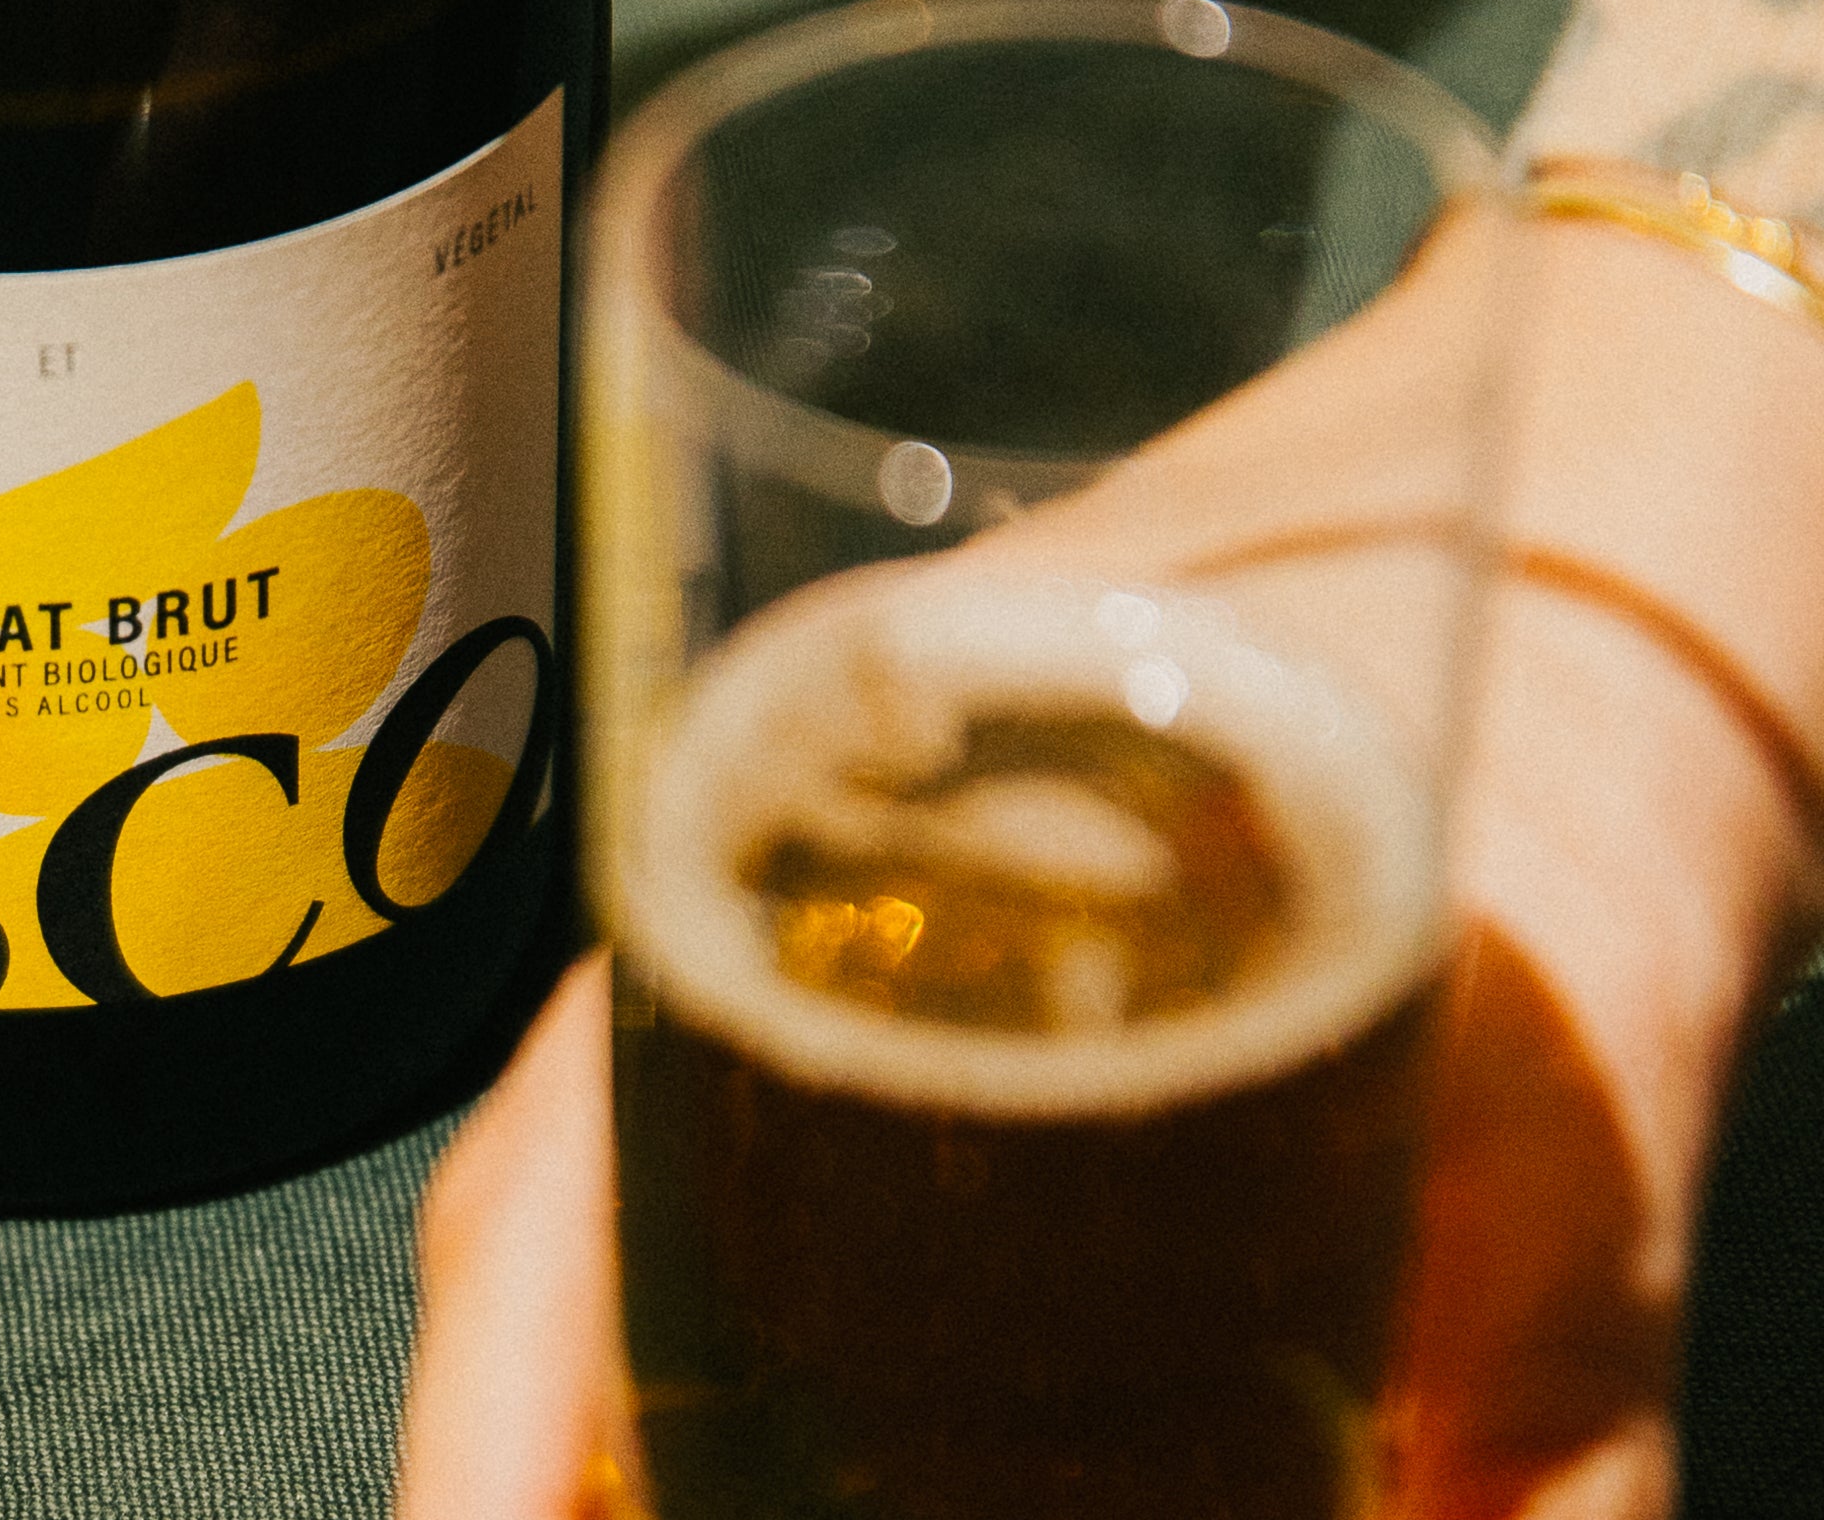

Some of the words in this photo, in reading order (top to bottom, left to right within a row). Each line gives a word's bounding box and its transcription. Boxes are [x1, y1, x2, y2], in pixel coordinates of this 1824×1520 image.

[39, 341, 77, 378] ET
[433, 182, 537, 276] VÉGÉTAL
[108, 566, 280, 645] BRUT
[44, 635, 240, 687] BIOLOGIQUE
[37, 687, 153, 716] ALCOOL
